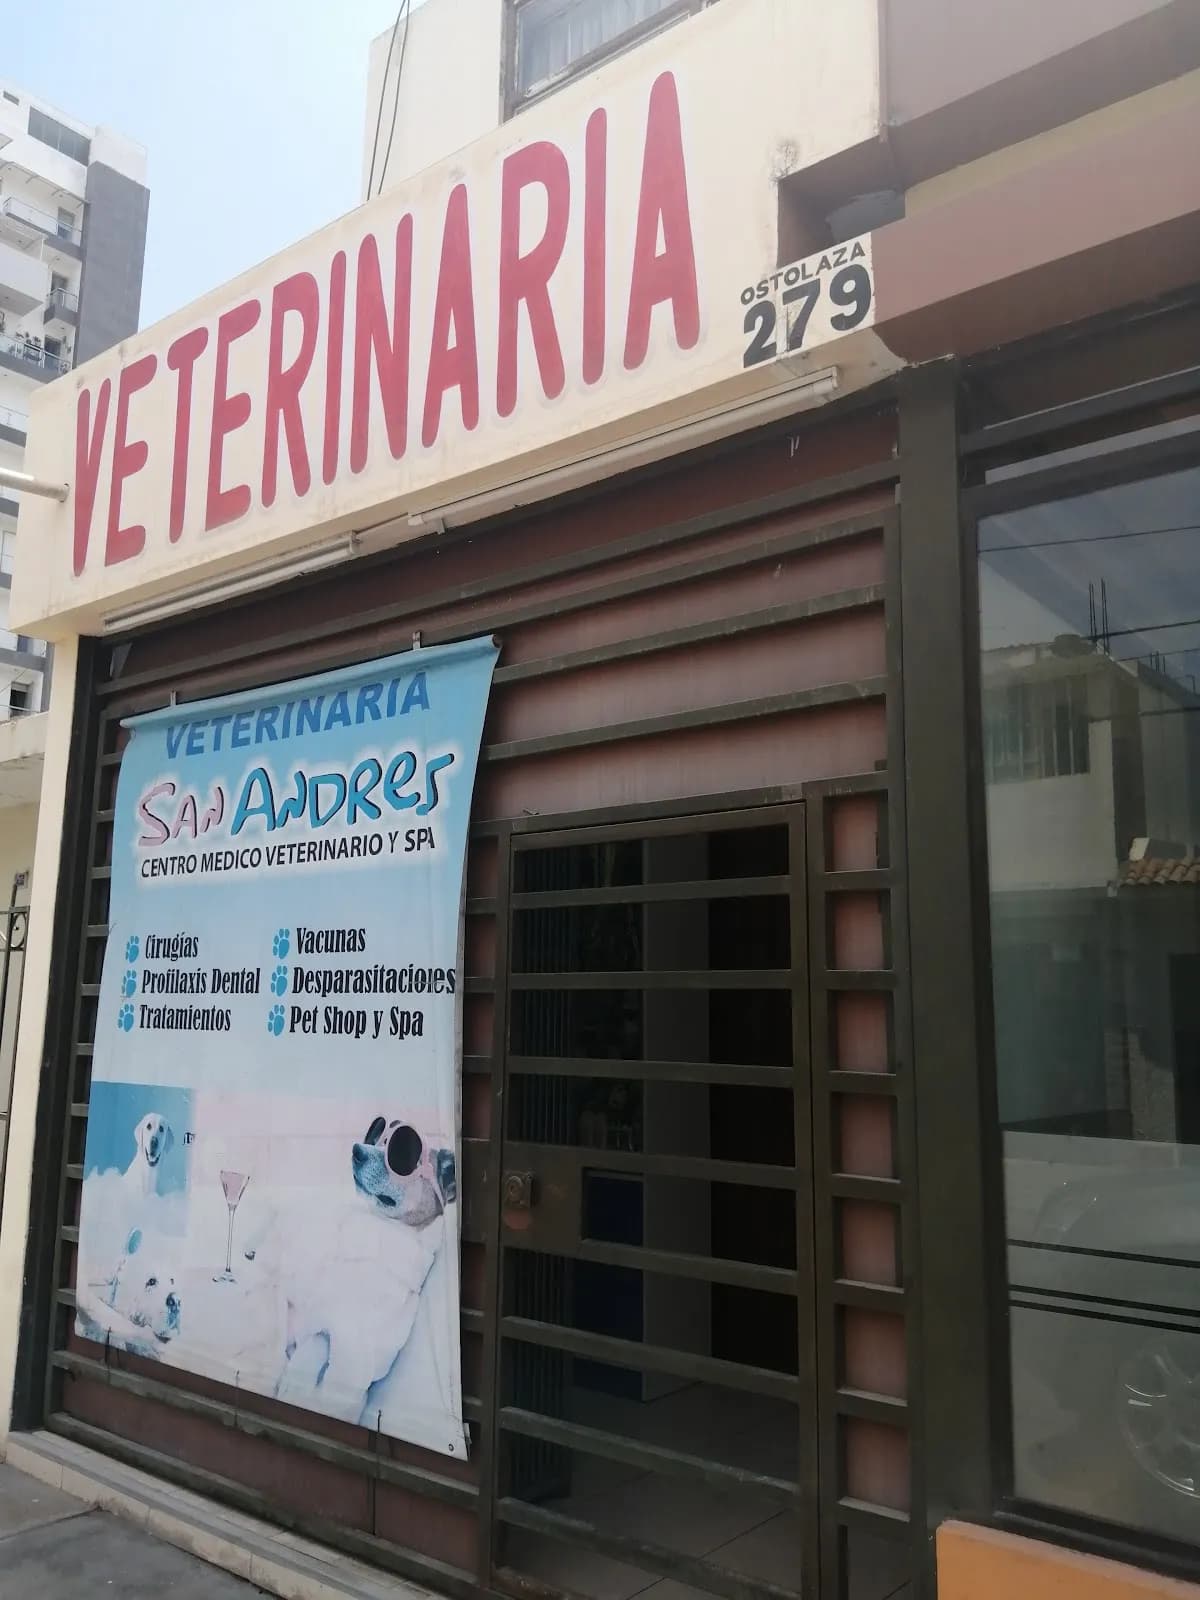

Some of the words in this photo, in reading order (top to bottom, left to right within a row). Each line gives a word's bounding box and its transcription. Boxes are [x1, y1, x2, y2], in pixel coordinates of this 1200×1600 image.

[740, 241, 865, 306] OSTOLAZA
[73, 71, 700, 577] VETERINARIA
[743, 264, 872, 368] 279
[166, 671, 430, 760] VETERINARIA
[138, 782, 225, 847] SAN
[141, 854, 197, 878] CENTRO
[200, 847, 262, 873] MEDICO
[265, 833, 383, 866] VETERINARIO
[388, 830, 400, 854] Y
[145, 931, 199, 962] Cirugías
[296, 927, 367, 954] Vacunas
[210, 967, 261, 994] Dental
[139, 1004, 232, 1032] Tratamientos
[289, 1005, 319, 1034] Pet
[323, 1006, 367, 1039] Shop
[372, 1010, 384, 1040] y
[389, 1006, 425, 1040] Spa
